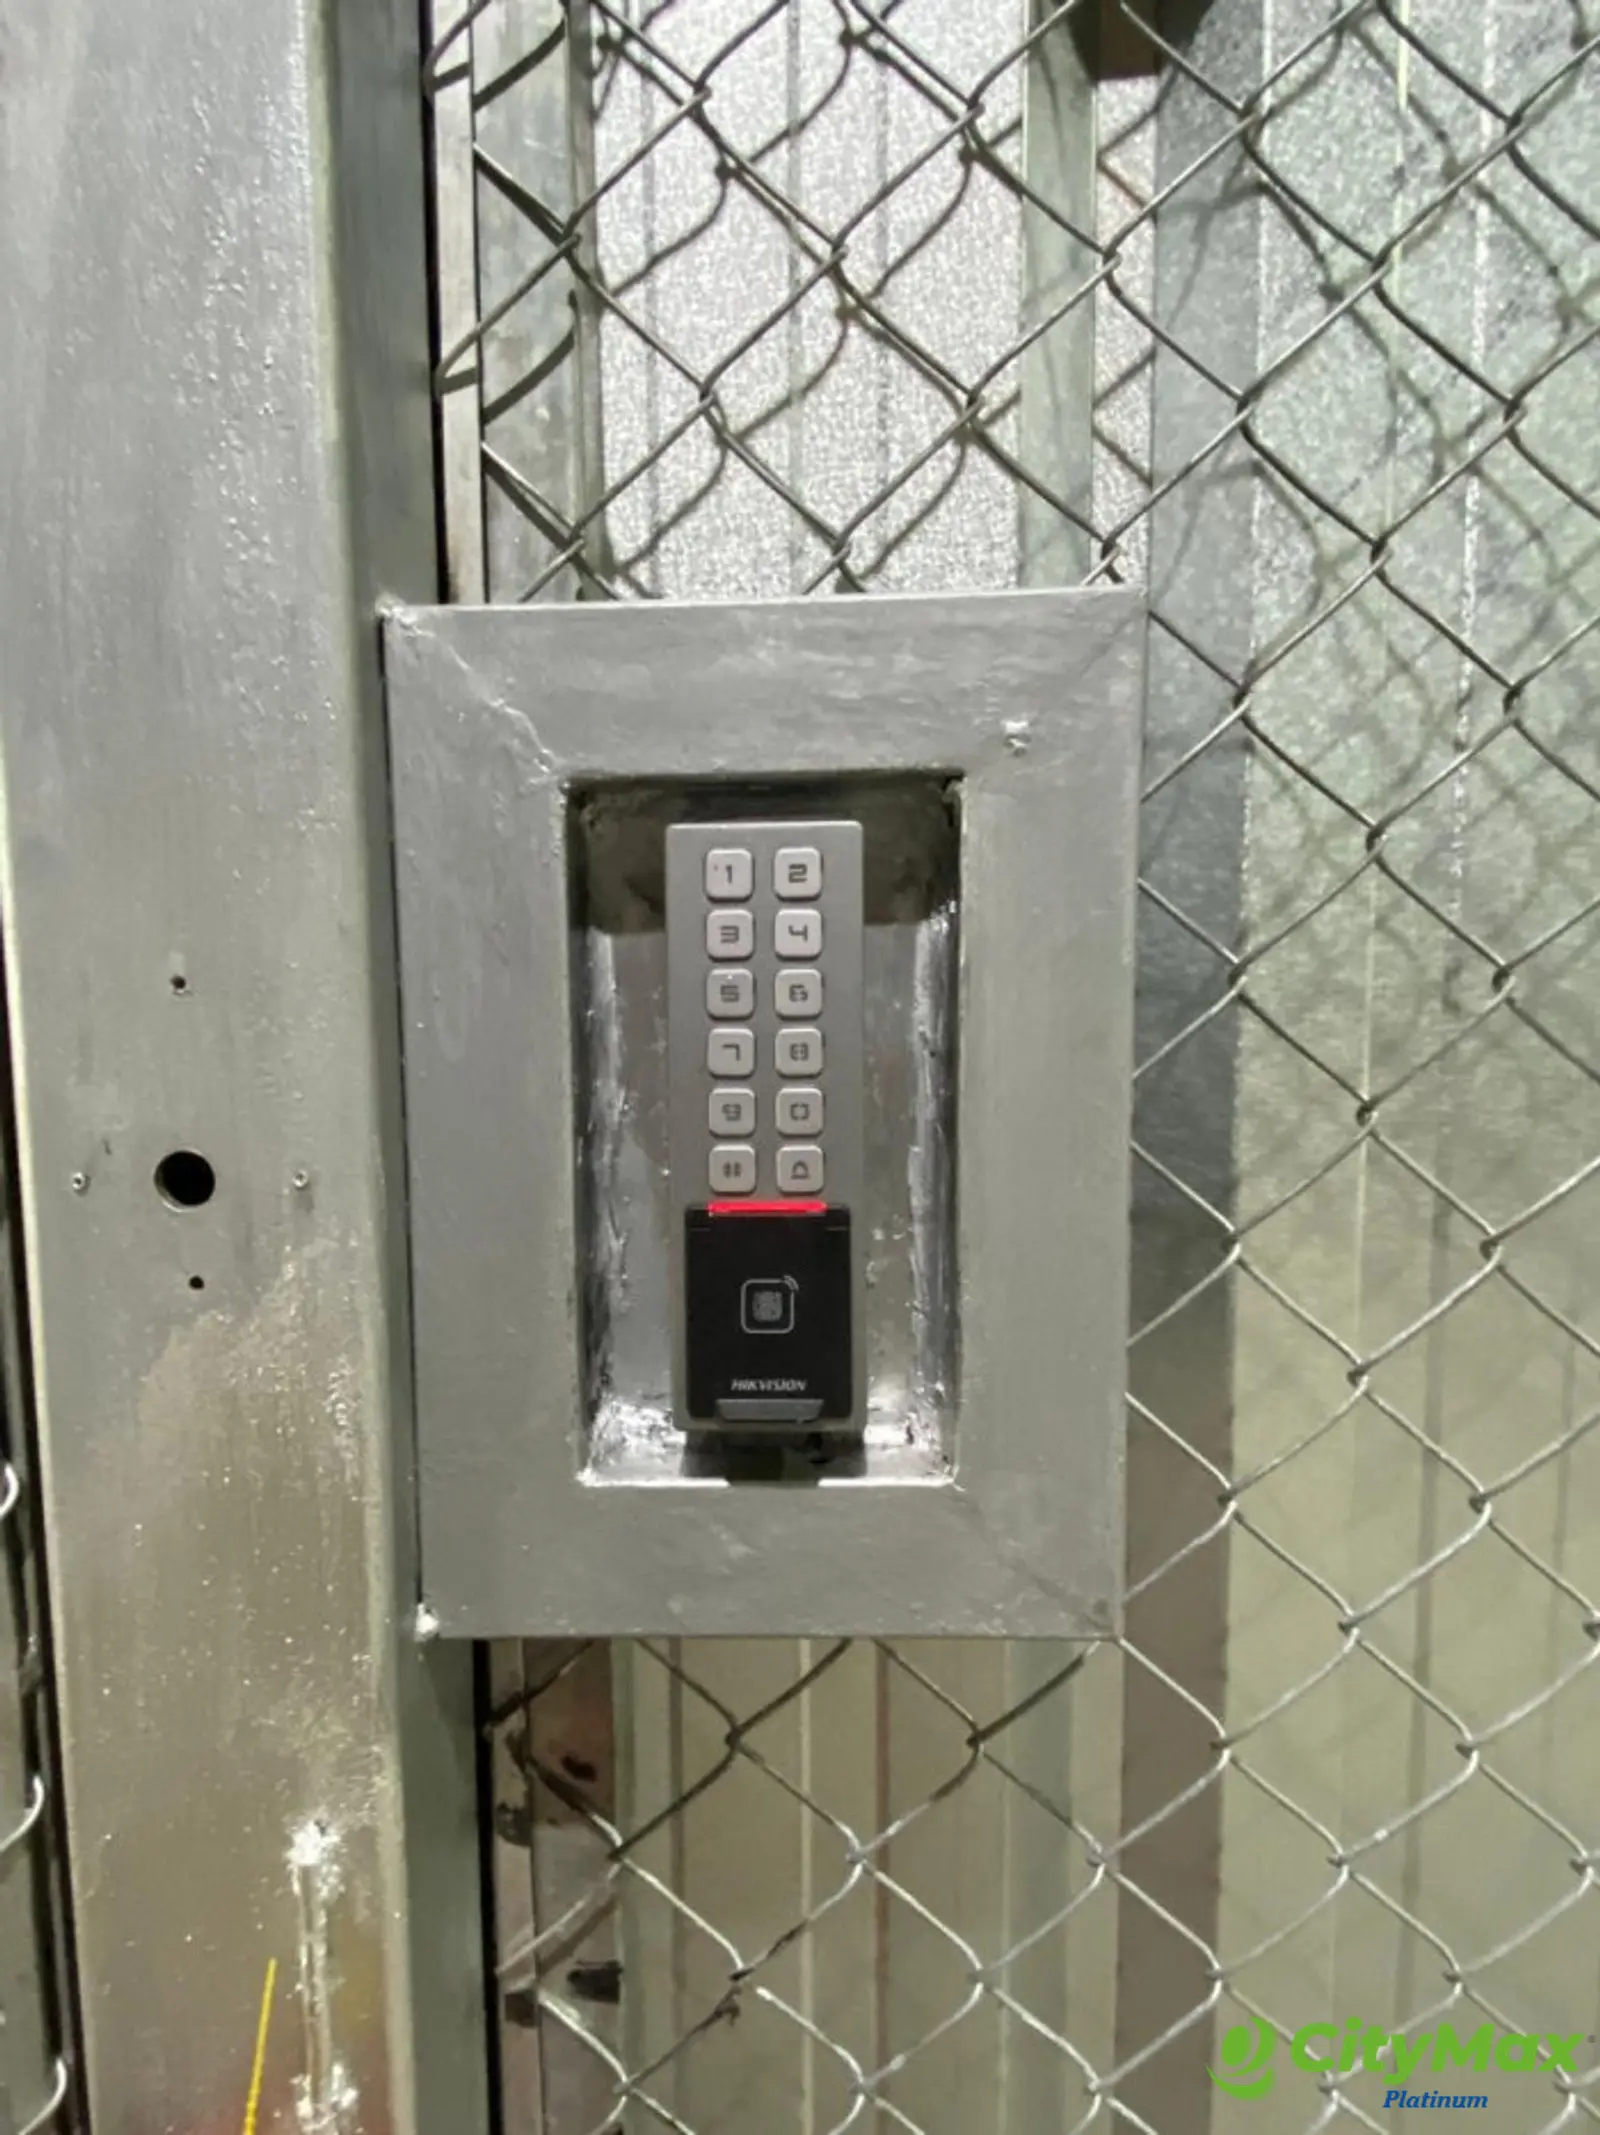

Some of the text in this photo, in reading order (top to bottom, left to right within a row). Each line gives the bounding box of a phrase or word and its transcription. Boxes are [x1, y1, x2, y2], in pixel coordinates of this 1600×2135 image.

[788, 863, 808, 884] 2
[720, 924, 808, 944] 3 4
[720, 984, 808, 1003] 5 6
[722, 1042, 809, 1062] 7 8
[722, 1103, 742, 1122] 9
[731, 1379, 807, 1391] HIKVISION
